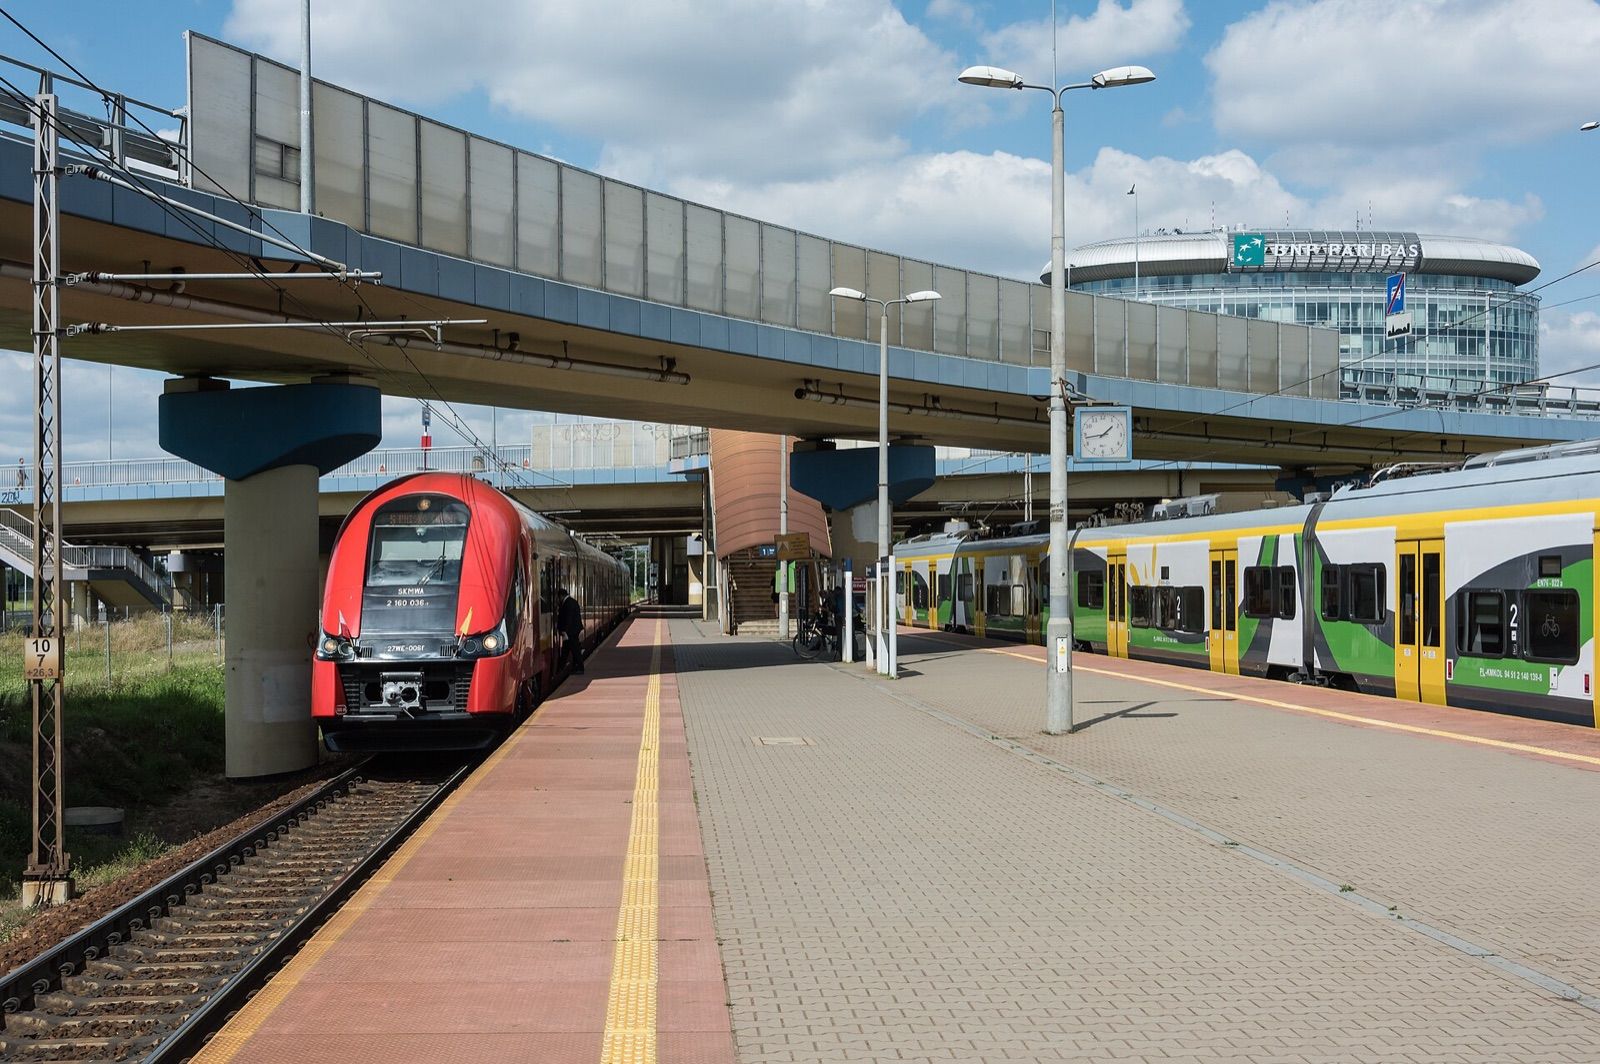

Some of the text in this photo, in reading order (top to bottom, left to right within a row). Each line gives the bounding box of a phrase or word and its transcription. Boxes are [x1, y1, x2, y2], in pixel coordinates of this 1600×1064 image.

[1274, 243, 1419, 258] BNP PARIBAS
[398, 587, 424, 595] SKMWA
[386, 599, 392, 607] 2
[394, 599, 407, 607] 160
[1176, 595, 1181, 611] 2
[1509, 603, 1518, 627] 2
[32, 639, 50, 653] 10
[36, 653, 46, 667] 7
[27, 668, 54, 678] +26,3
